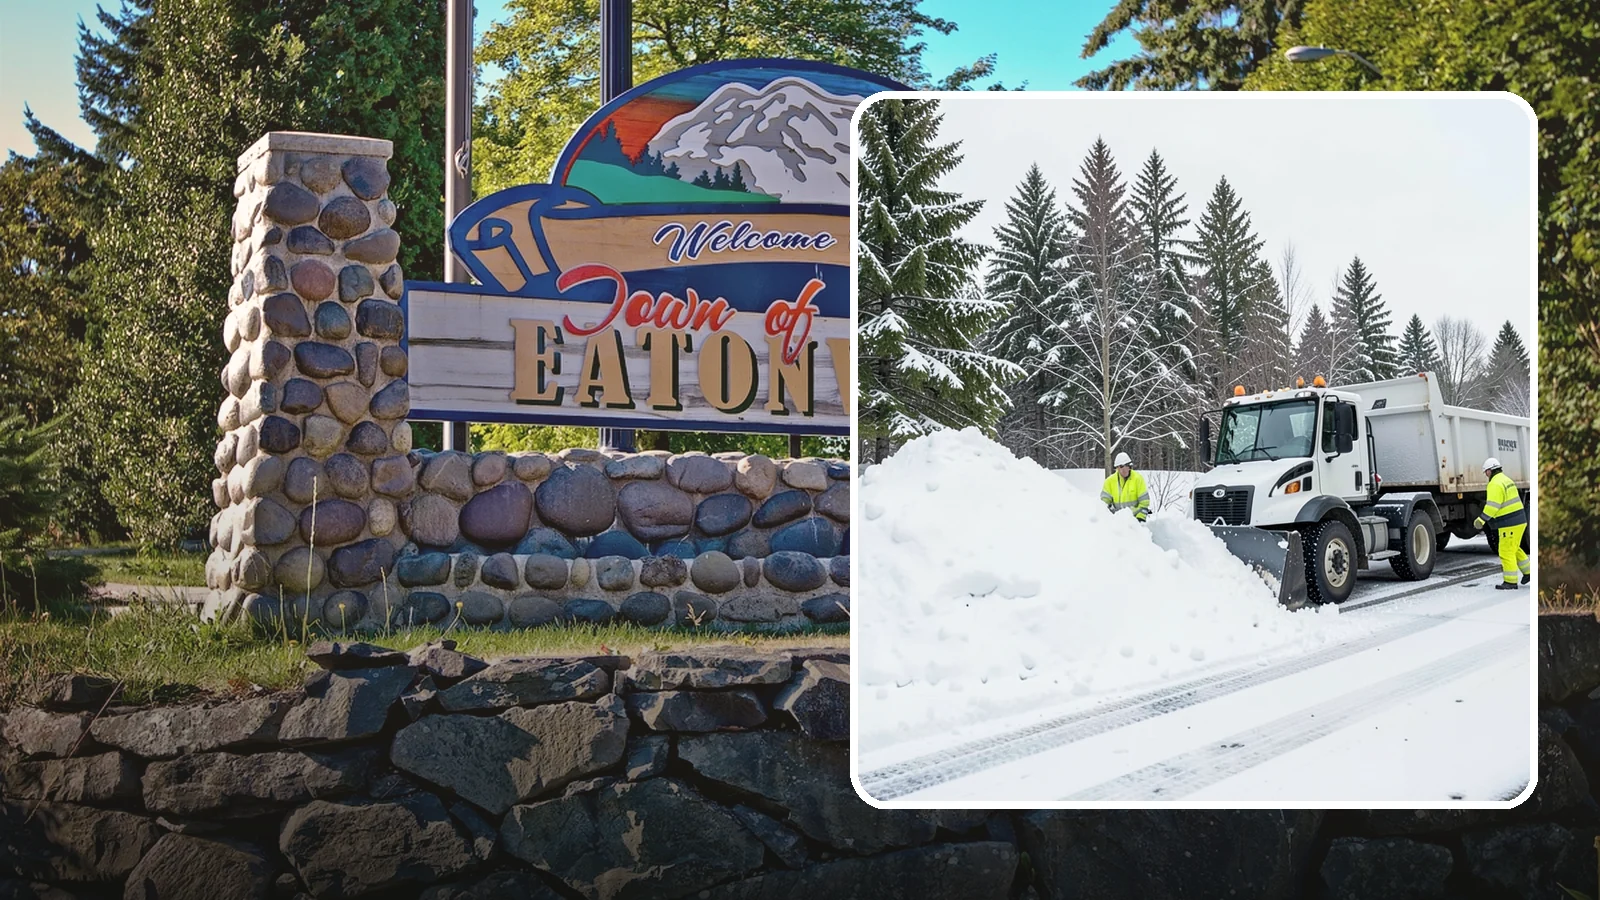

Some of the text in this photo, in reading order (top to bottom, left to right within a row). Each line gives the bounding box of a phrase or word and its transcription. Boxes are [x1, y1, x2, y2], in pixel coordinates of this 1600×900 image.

[654, 221, 837, 263] Welcome
[556, 263, 827, 365] Town of
